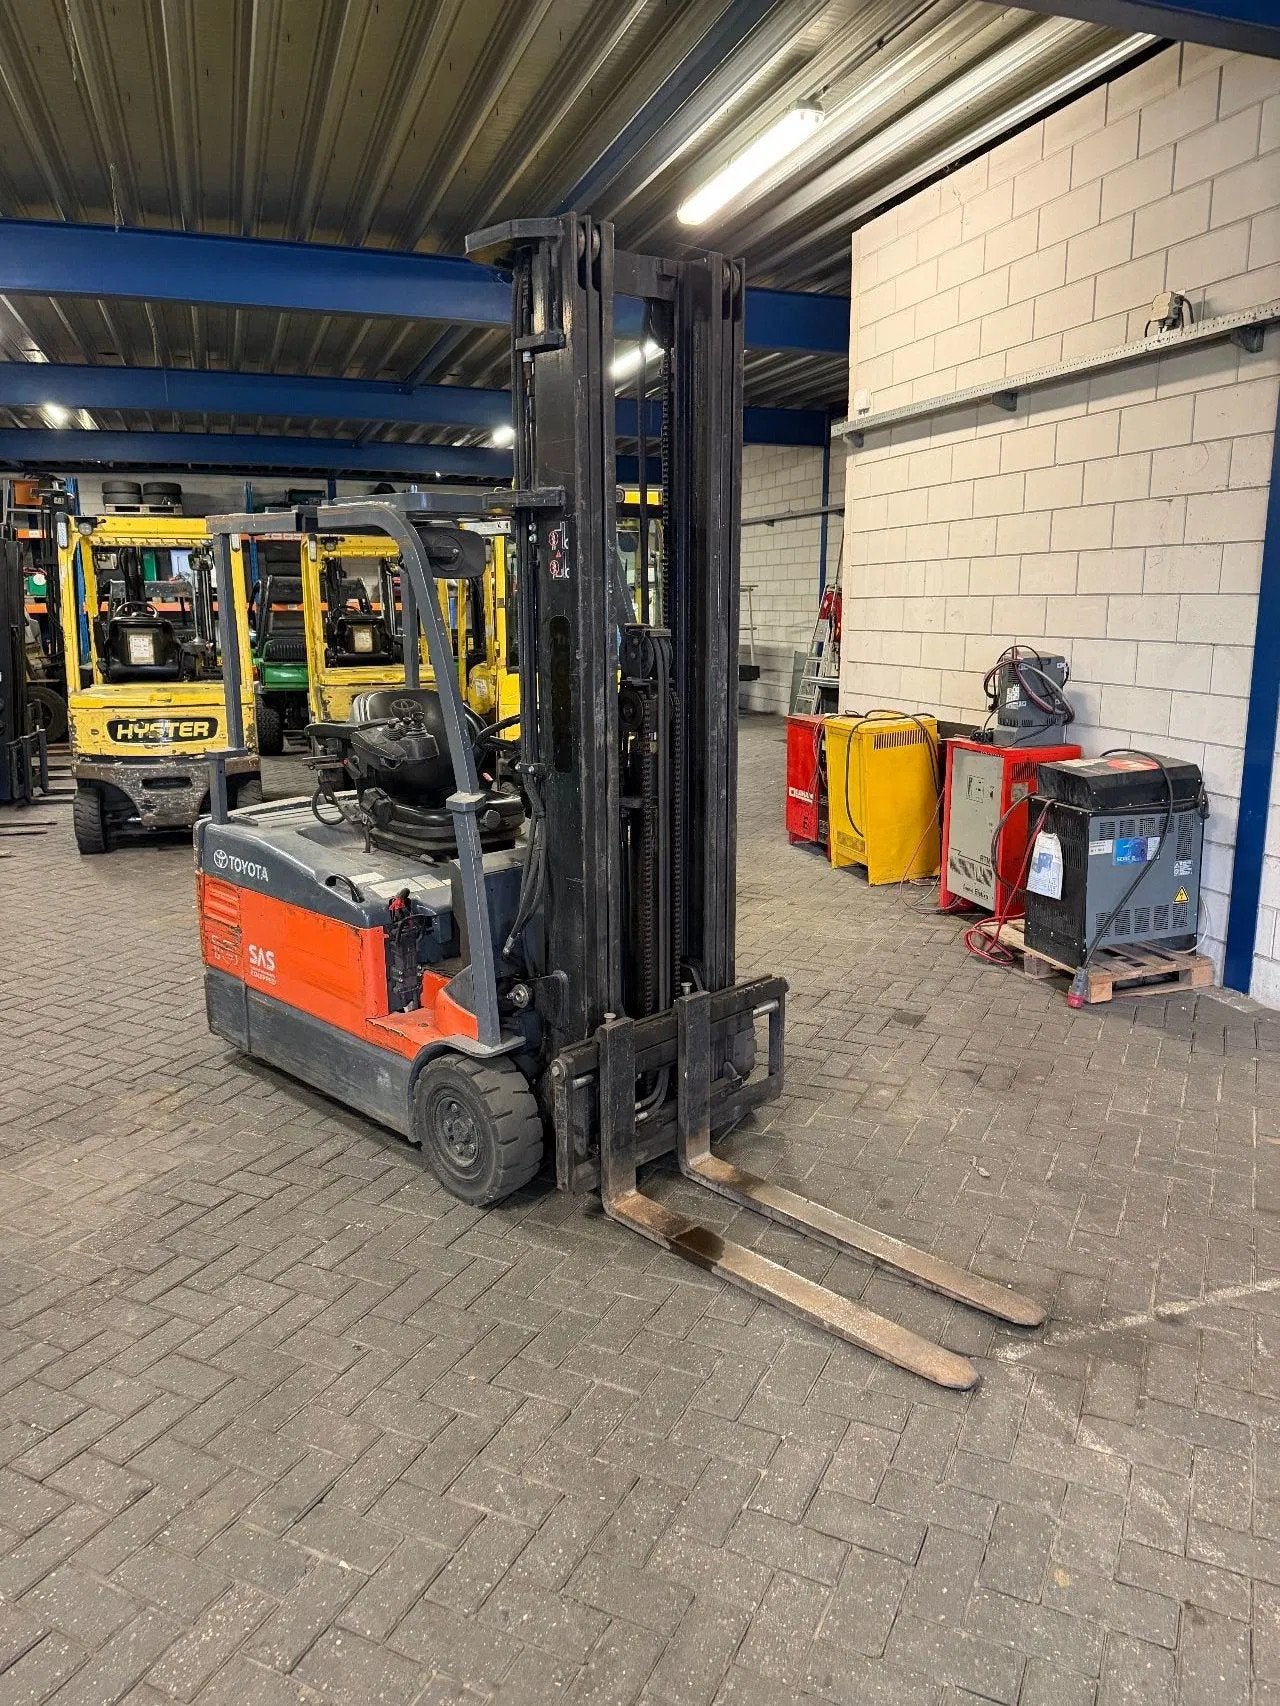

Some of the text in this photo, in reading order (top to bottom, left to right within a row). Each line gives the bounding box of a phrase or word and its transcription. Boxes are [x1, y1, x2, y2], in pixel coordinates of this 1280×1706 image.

[116, 721, 210, 740] HYSTER
[228, 855, 269, 882] TOYOTA
[248, 943, 276, 971] SAS
